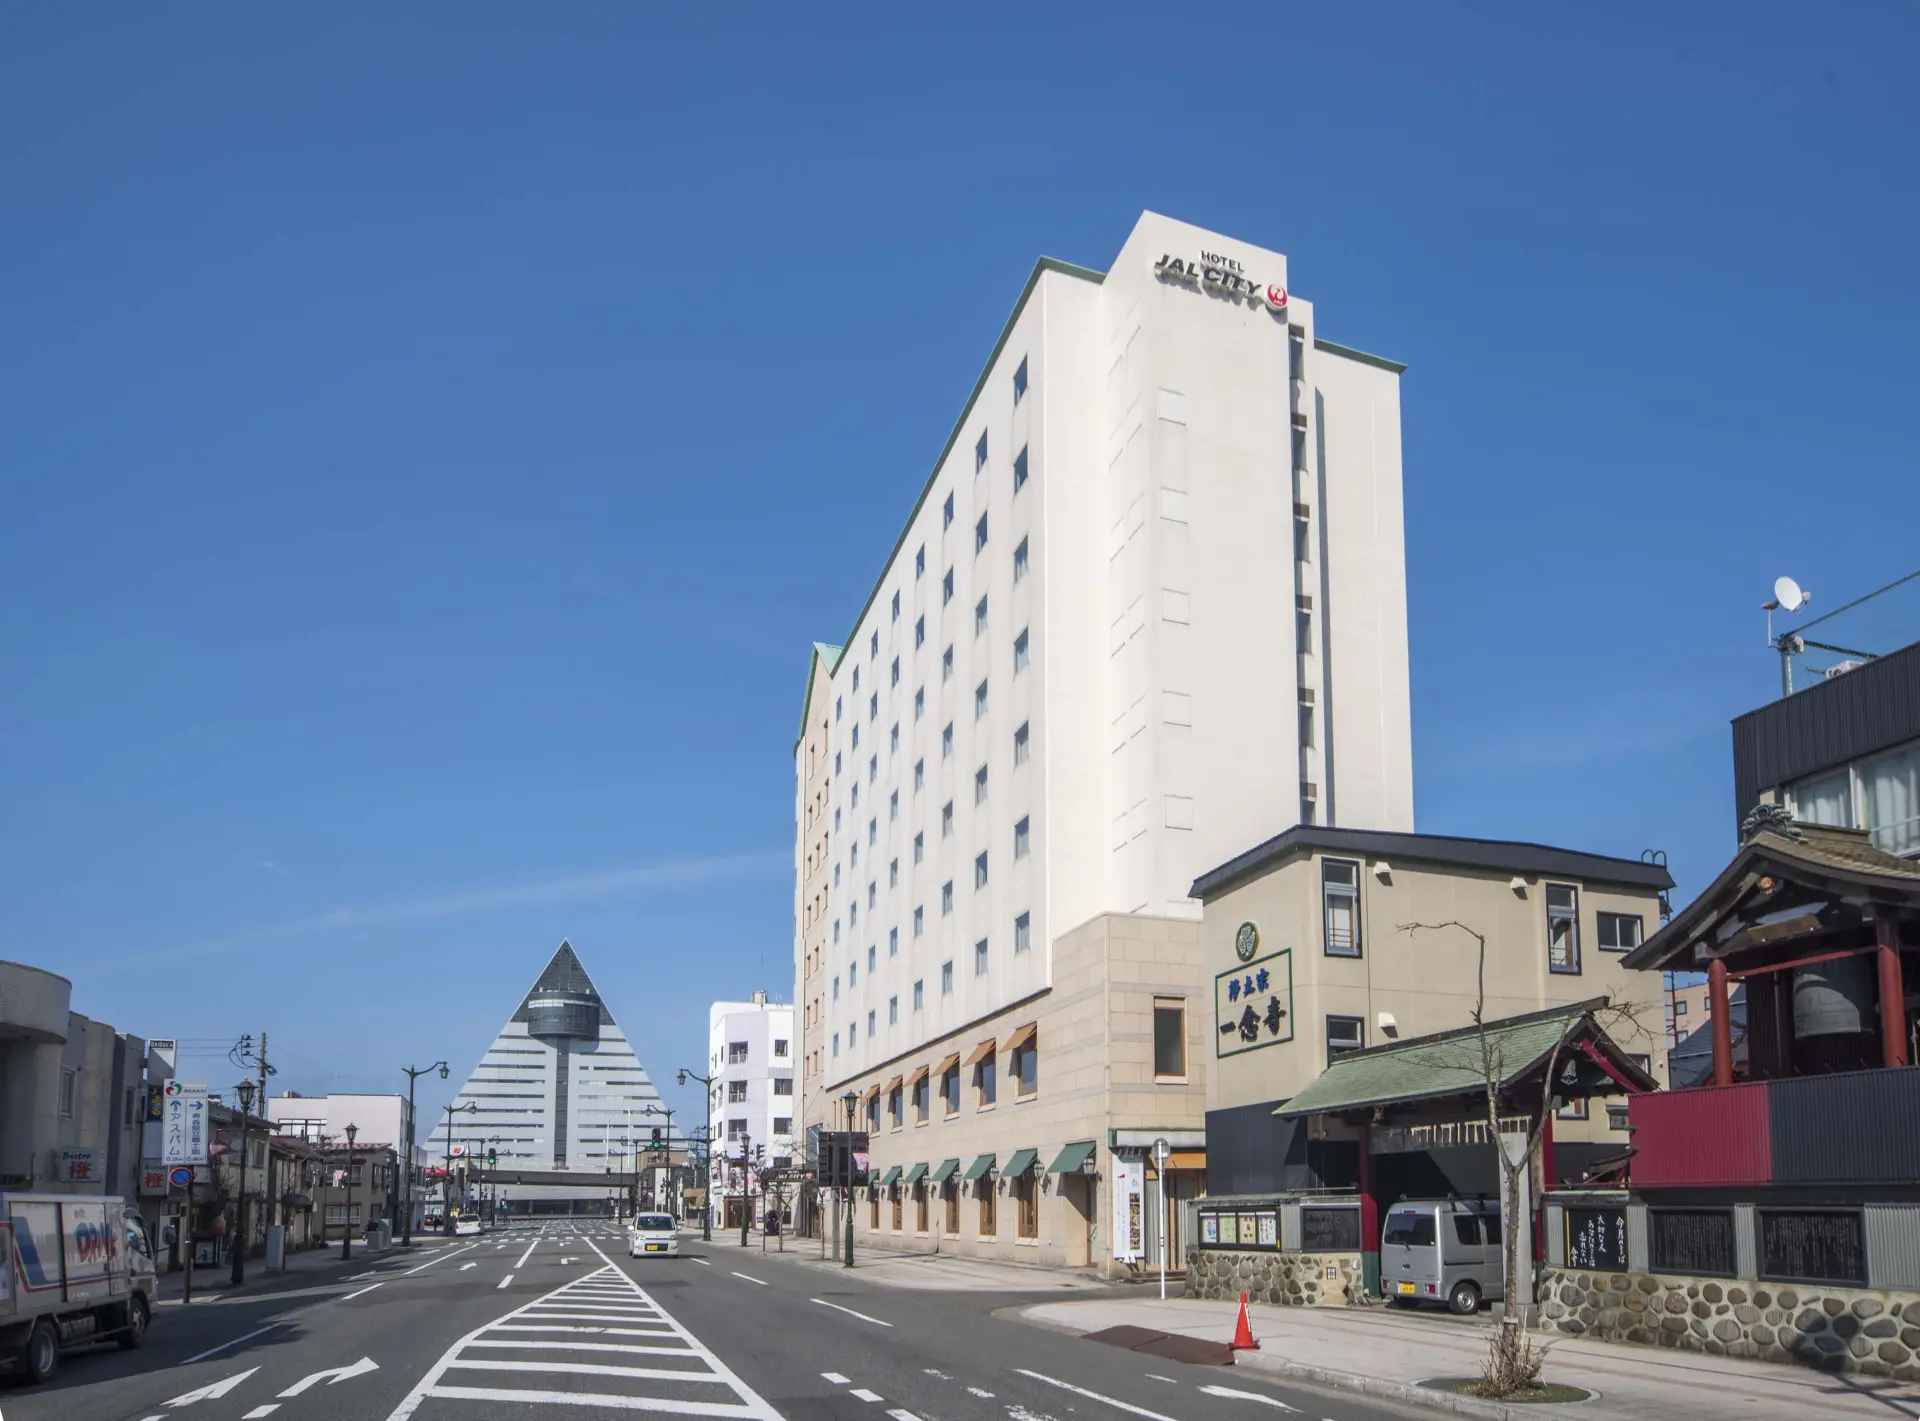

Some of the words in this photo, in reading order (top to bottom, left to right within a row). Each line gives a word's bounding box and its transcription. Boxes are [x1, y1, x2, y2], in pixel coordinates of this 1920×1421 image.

[1154, 254, 1199, 278] JAL
[1203, 268, 1262, 296] CITY
[1201, 250, 1244, 273] HOTEL
[169, 1113, 182, 1155] アスパム
[1597, 1214, 1606, 1252] 大切な人
